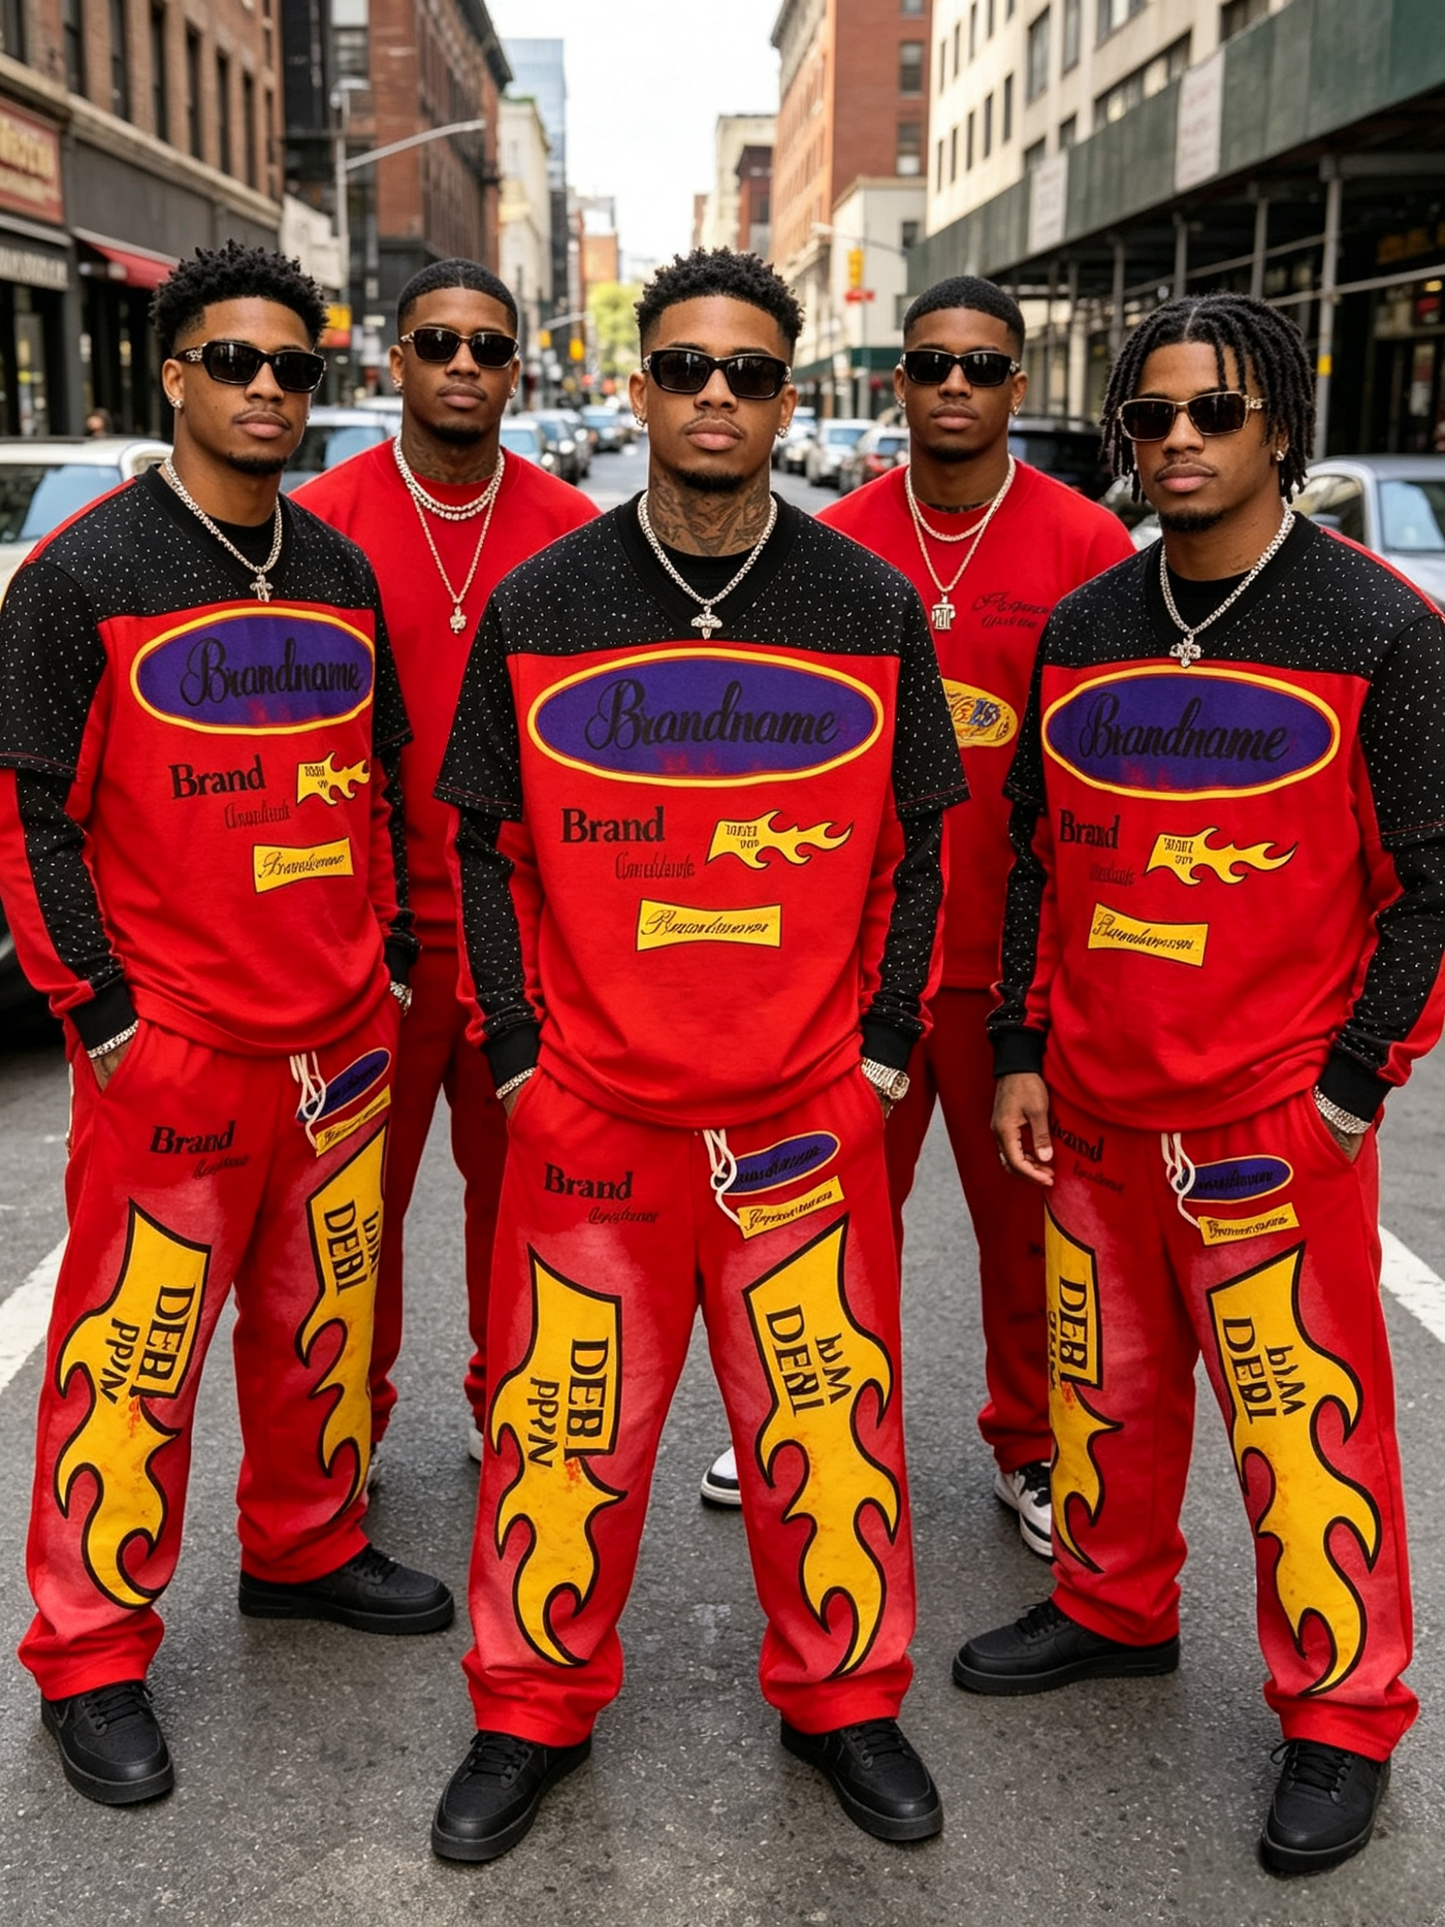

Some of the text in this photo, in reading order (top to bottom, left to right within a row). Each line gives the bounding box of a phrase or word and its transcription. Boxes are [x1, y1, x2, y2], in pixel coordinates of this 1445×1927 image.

[180, 638, 364, 707] Brandname
[585, 678, 838, 751] Brandname
[1080, 693, 1290, 761] Brandname
[169, 754, 265, 799] Brand
[561, 806, 664, 843] Brand
[1059, 809, 1118, 849] Brand
[150, 1120, 236, 1154] Brand
[544, 1163, 633, 1200] Brand
